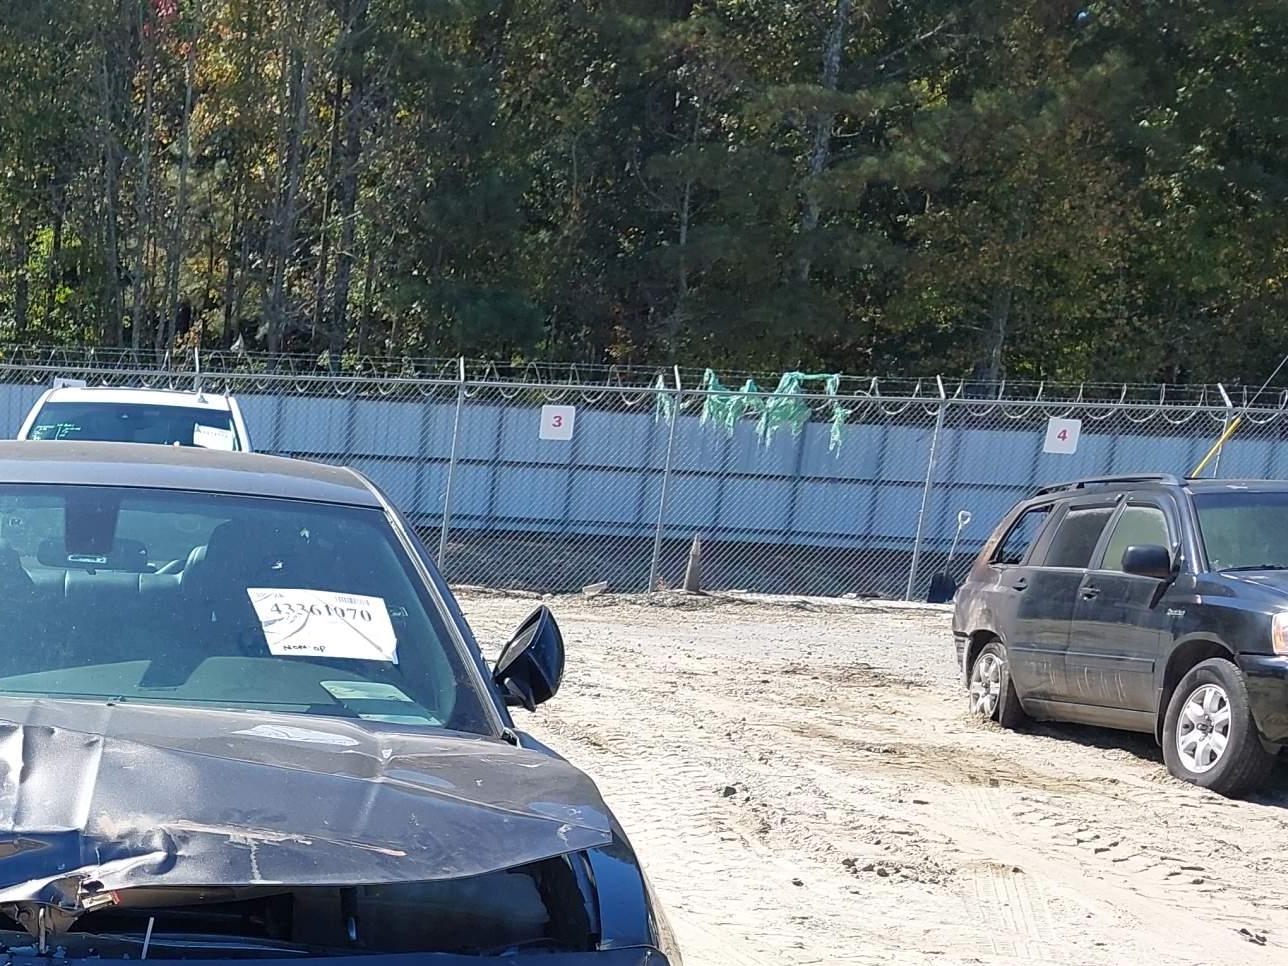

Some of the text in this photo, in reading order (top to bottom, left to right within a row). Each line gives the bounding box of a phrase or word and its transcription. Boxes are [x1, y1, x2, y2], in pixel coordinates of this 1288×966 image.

[552, 415, 562, 428] 3
[1057, 429, 1068, 441] 4
[270, 602, 372, 622] 43361070
